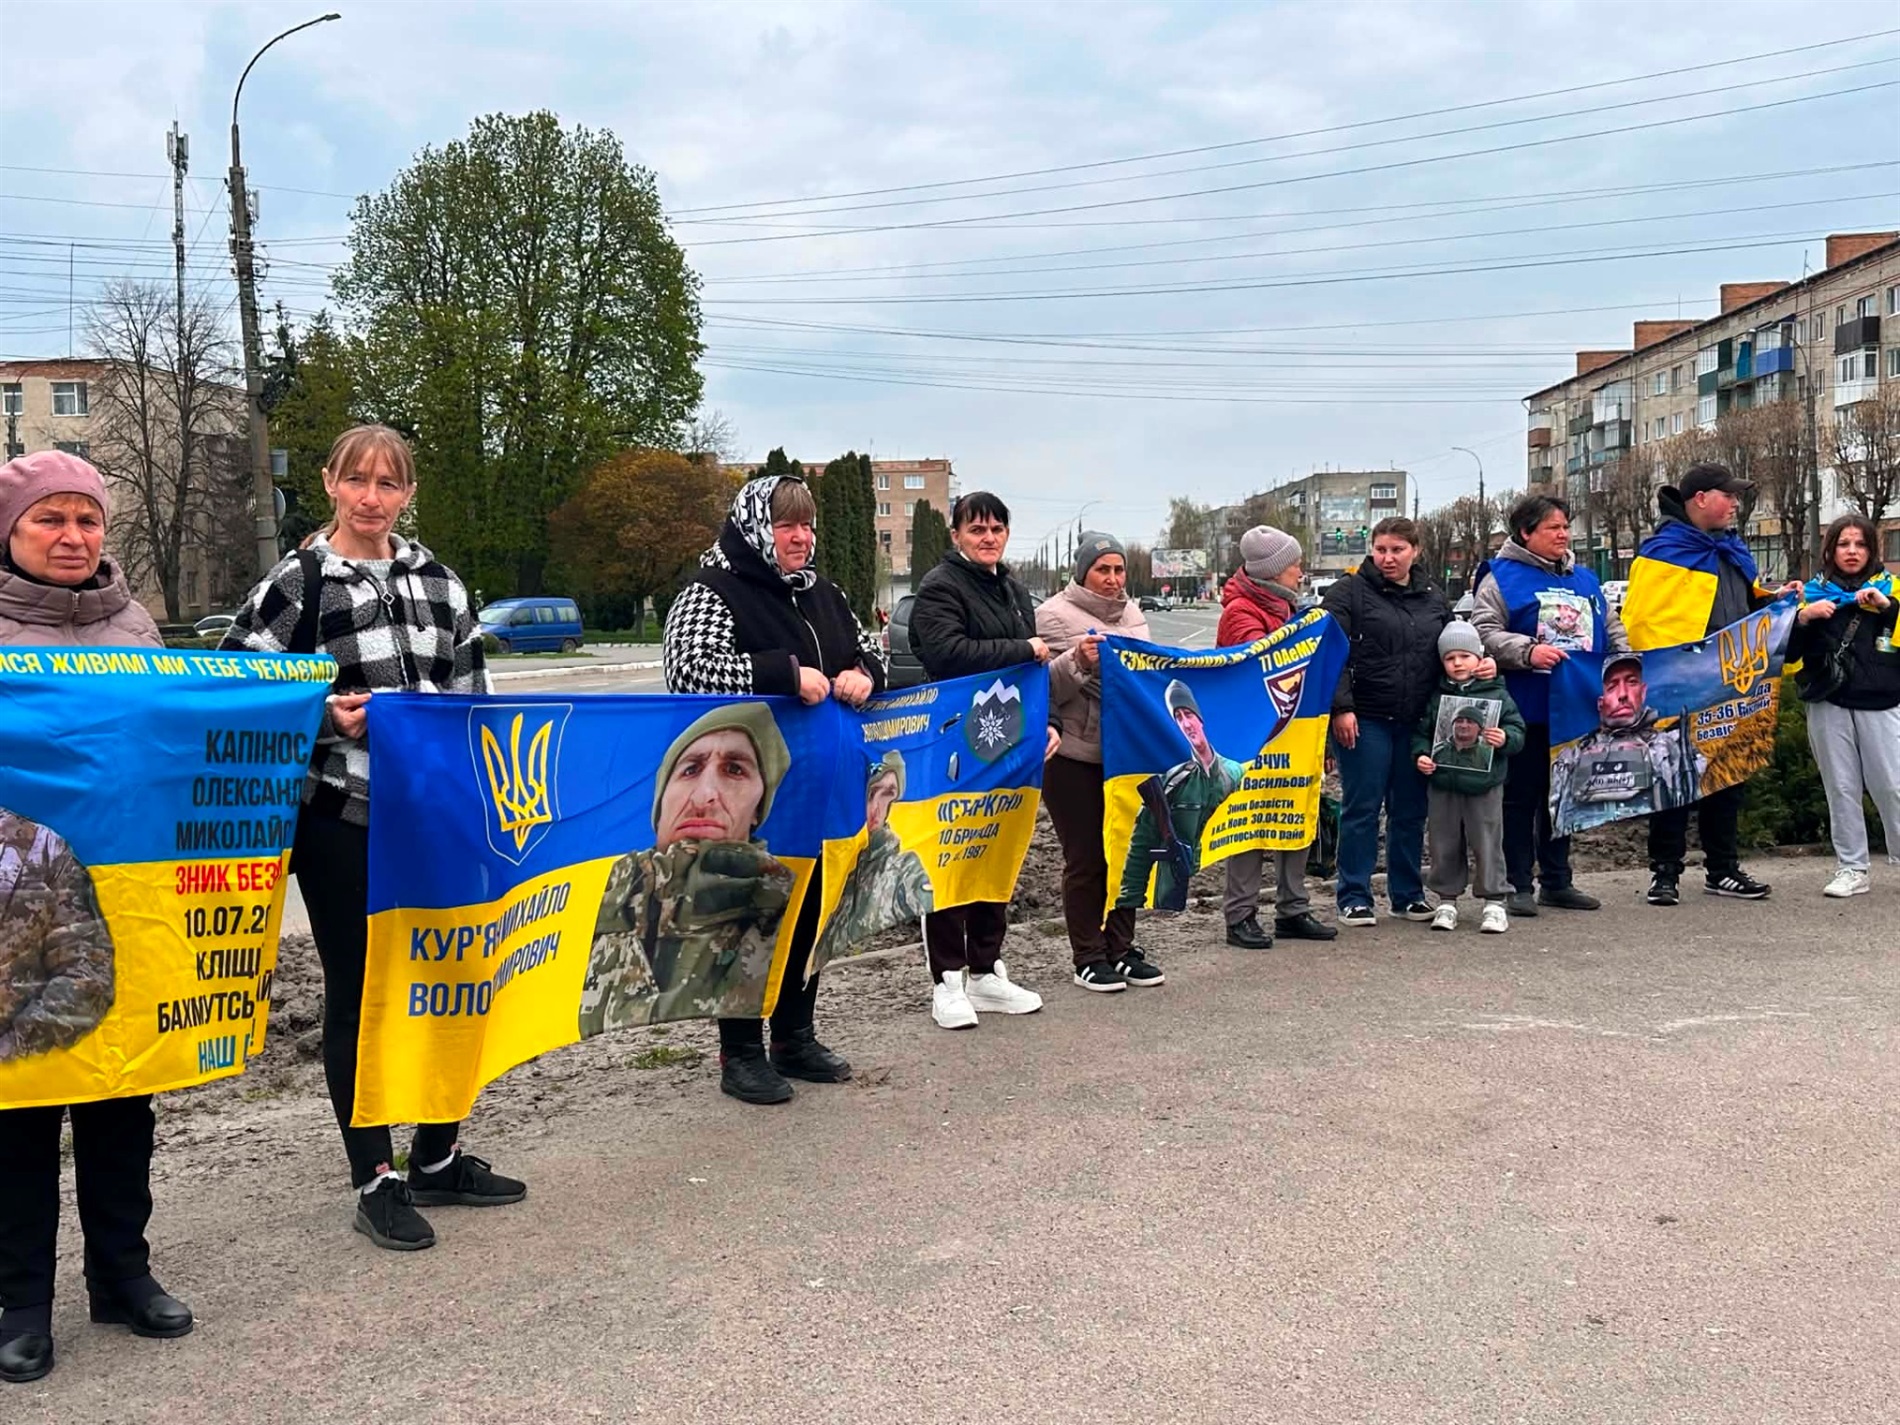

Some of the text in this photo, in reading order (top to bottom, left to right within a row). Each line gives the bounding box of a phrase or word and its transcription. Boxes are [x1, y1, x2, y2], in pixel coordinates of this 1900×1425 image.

[45, 652, 152, 675] ЖИВИМ!
[151, 654, 192, 676] МИ
[190, 656, 247, 679] ТЕБЕ
[1258, 653, 1273, 673] 77
[1697, 704, 1735, 726] 35-36
[205, 729, 309, 765] КАПІНОС
[1248, 753, 1291, 771] ВЧУК
[1250, 812, 1305, 825] 30.04.2025
[175, 864, 231, 896] ЗНИК
[198, 1035, 236, 1074] НАШ
